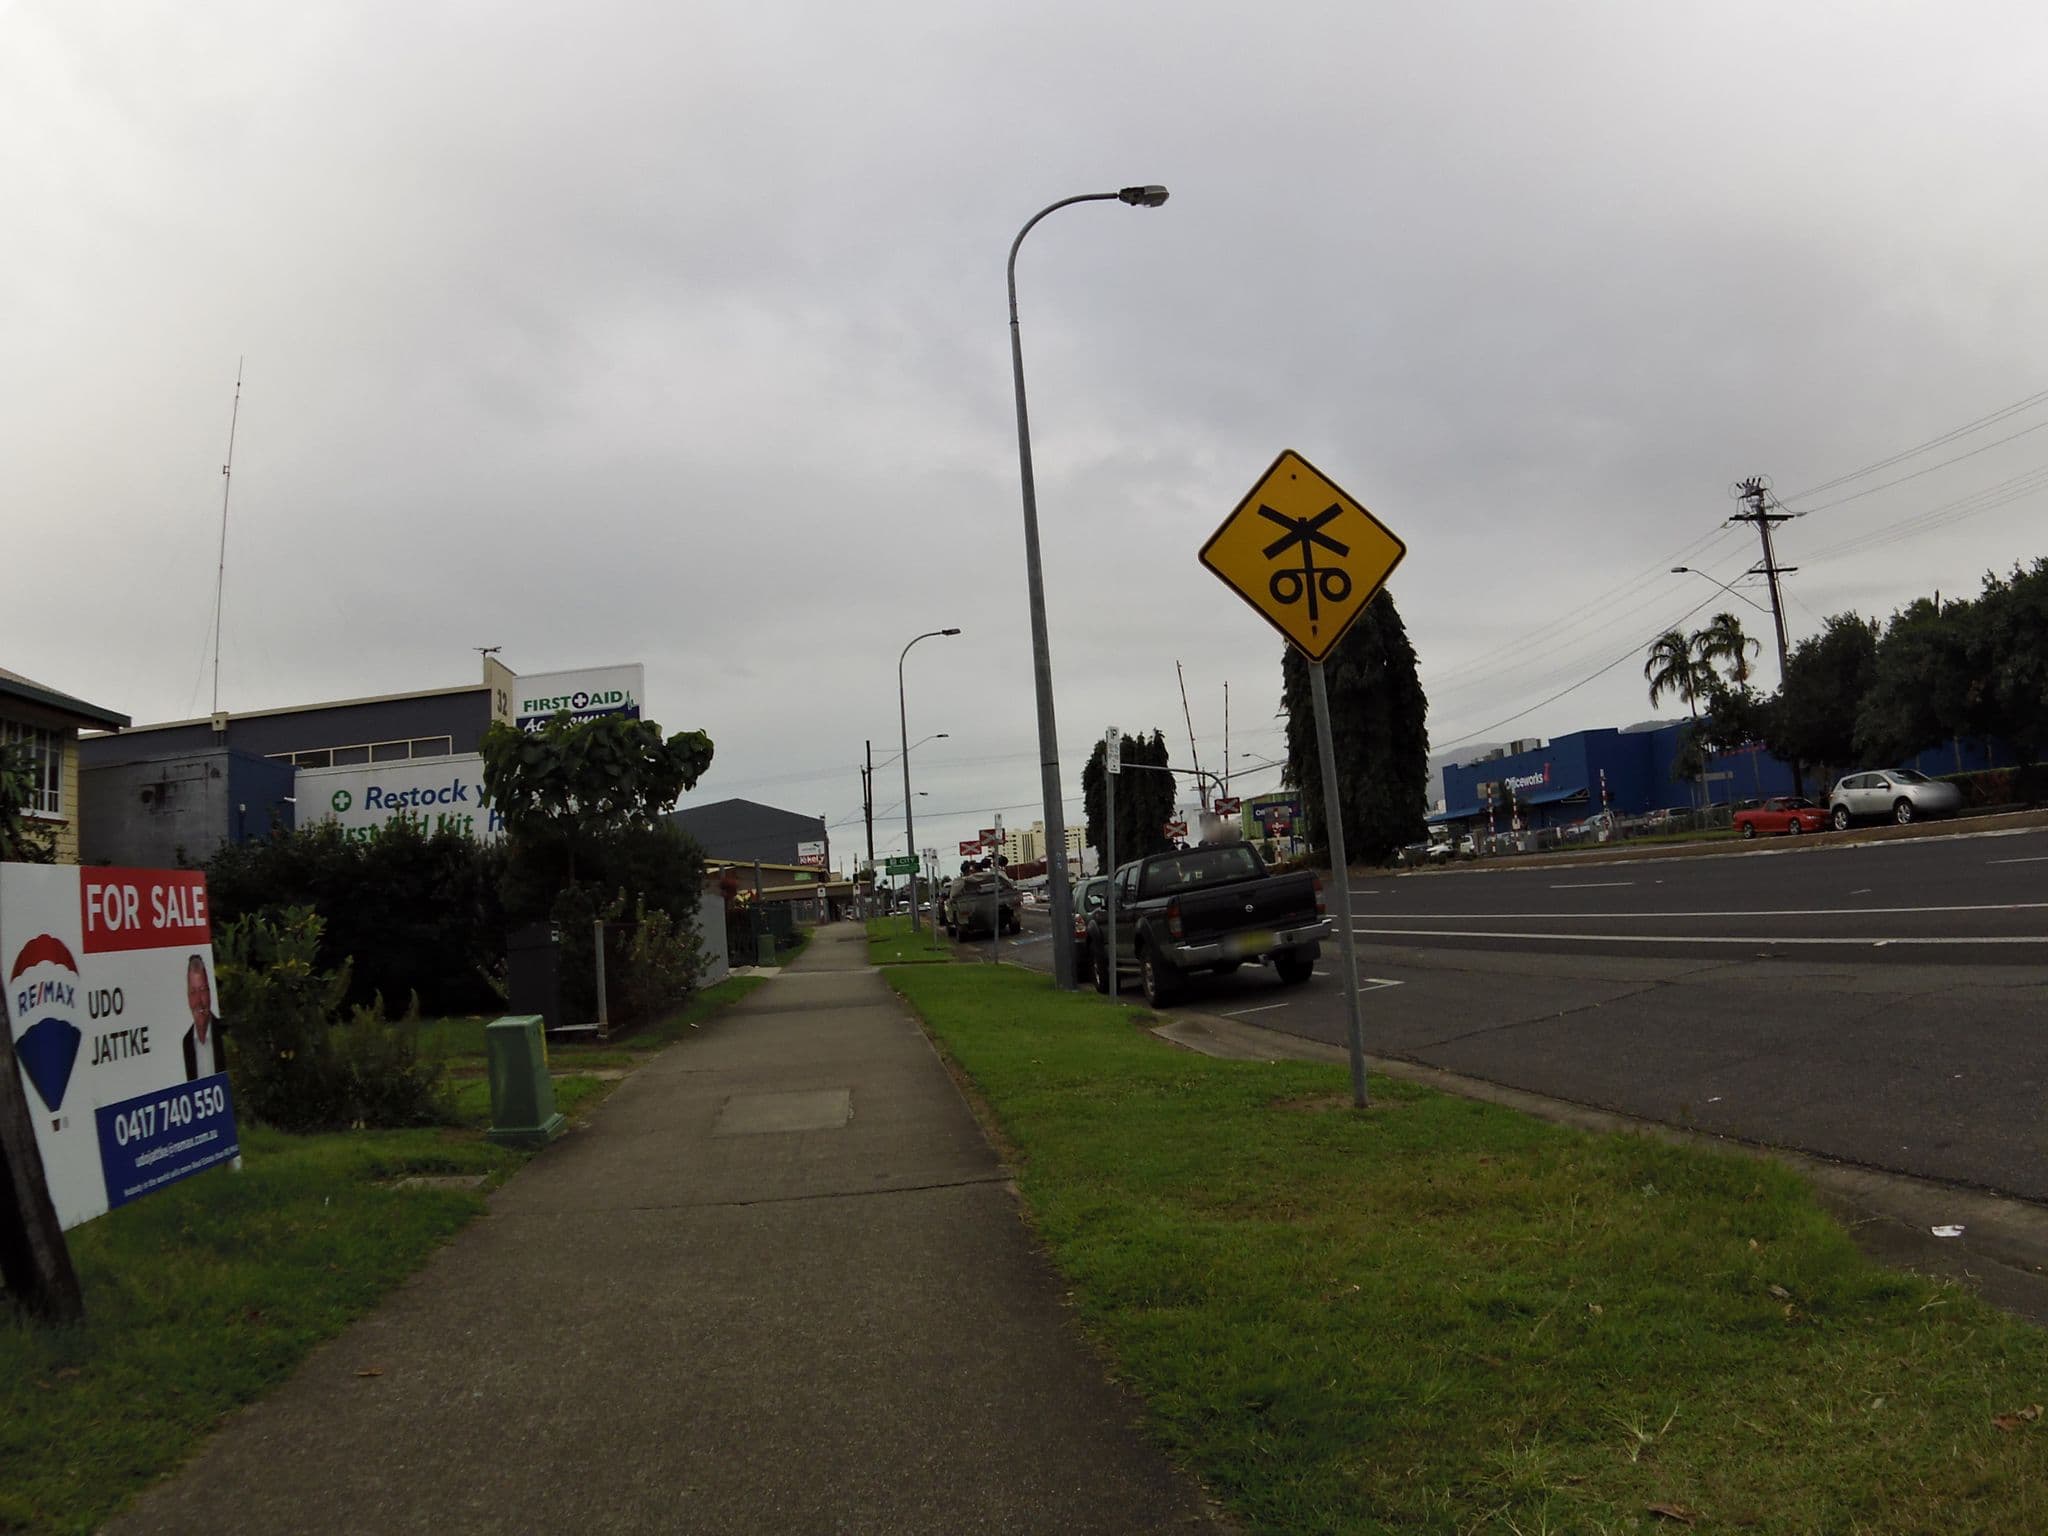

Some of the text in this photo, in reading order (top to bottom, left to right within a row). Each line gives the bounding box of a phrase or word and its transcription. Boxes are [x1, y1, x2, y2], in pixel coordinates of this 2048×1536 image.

[497, 685, 508, 717] 32
[523, 690, 623, 713] FIRST AID
[364, 778, 468, 810] Restock
[1504, 772, 1544, 790] Officeworks
[86, 883, 207, 932] FOR SALE
[17, 981, 76, 1017] RE/MAX
[87, 987, 125, 1020] UDO
[91, 1026, 151, 1066] JATTKE
[114, 1084, 225, 1147] 0417 740 550
